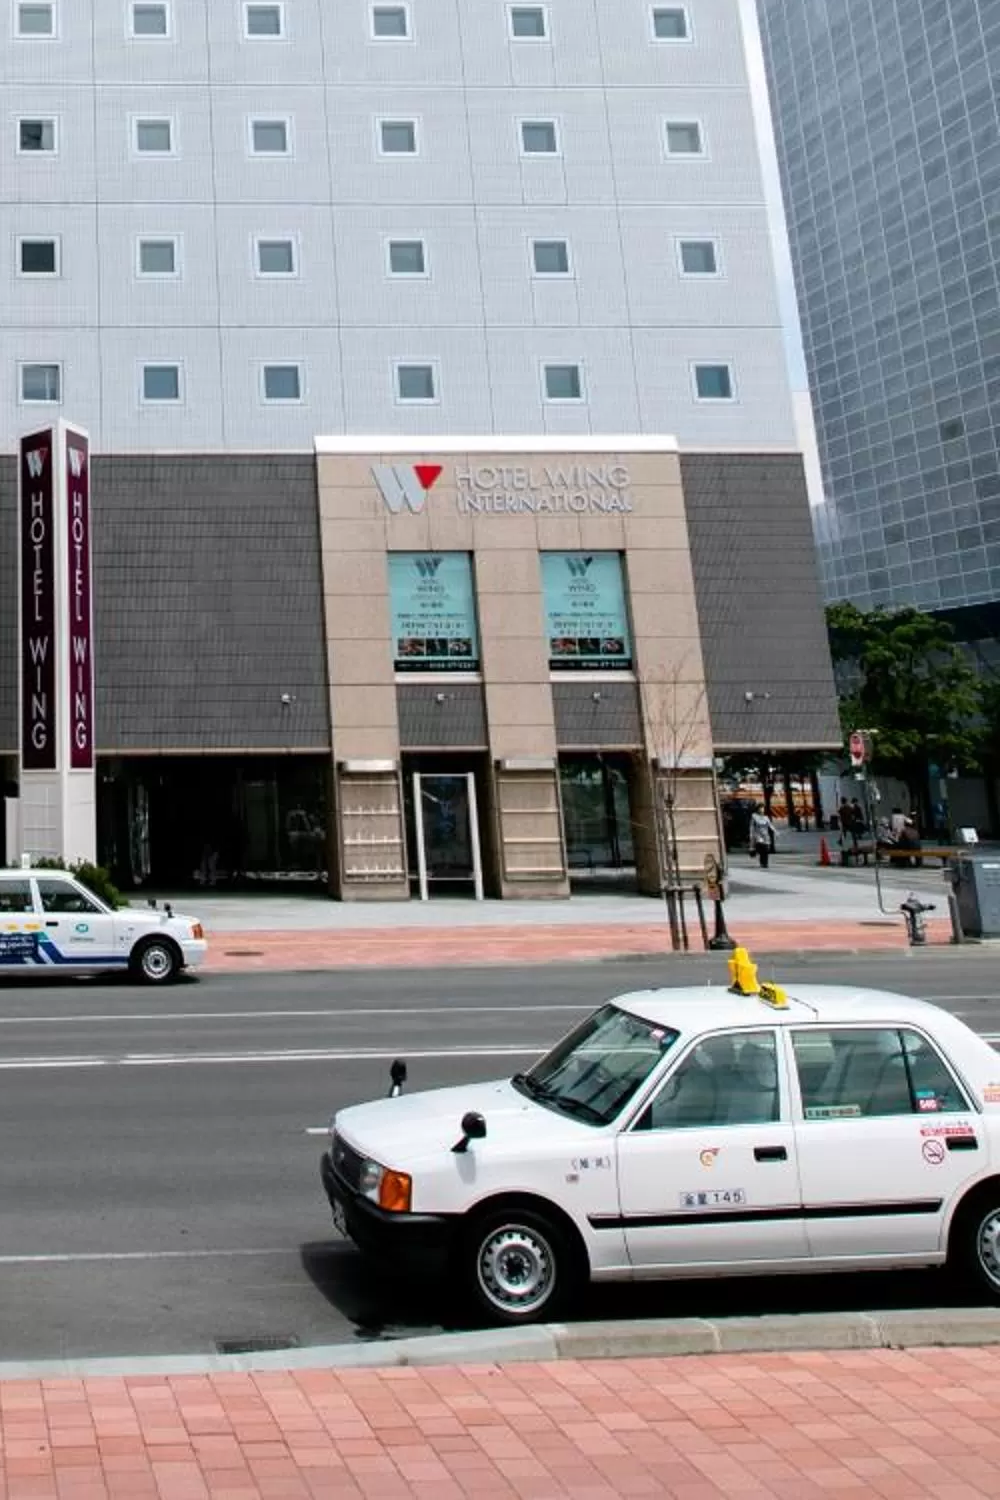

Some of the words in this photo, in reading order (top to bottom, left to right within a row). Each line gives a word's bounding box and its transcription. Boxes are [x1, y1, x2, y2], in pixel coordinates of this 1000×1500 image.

[30, 491, 46, 622] HOTEL
[72, 492, 84, 622] HOTEL
[456, 492, 633, 513] INTERNATIONAL
[29, 636, 49, 750] WING
[72, 636, 87, 750] WING
[713, 1191, 741, 1204] 145
